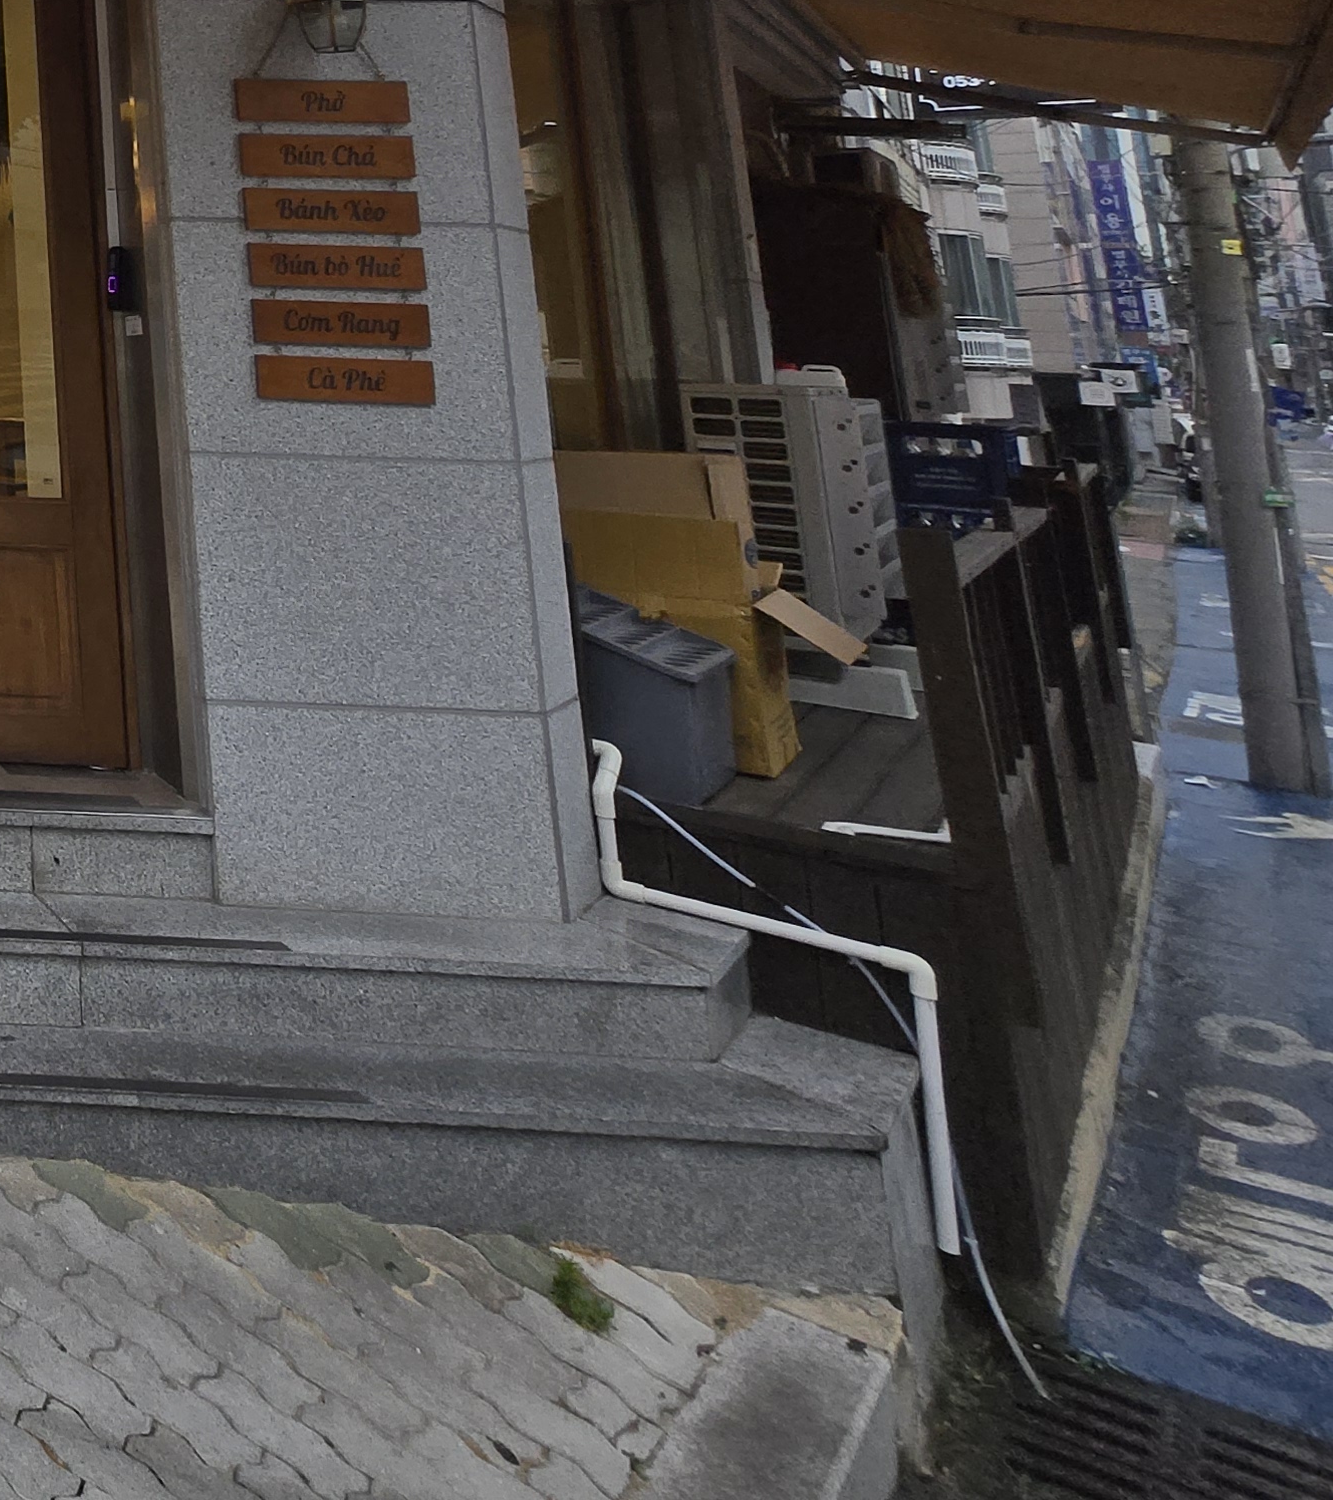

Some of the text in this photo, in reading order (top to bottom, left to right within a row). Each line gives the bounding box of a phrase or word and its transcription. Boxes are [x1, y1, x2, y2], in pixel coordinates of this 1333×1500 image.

[280, 144, 327, 167] Bún
[276, 198, 339, 221] Bánh
[270, 252, 405, 278] Bún bò Huế
[337, 311, 400, 341] Rang
[307, 367, 387, 392] Cà Phê
